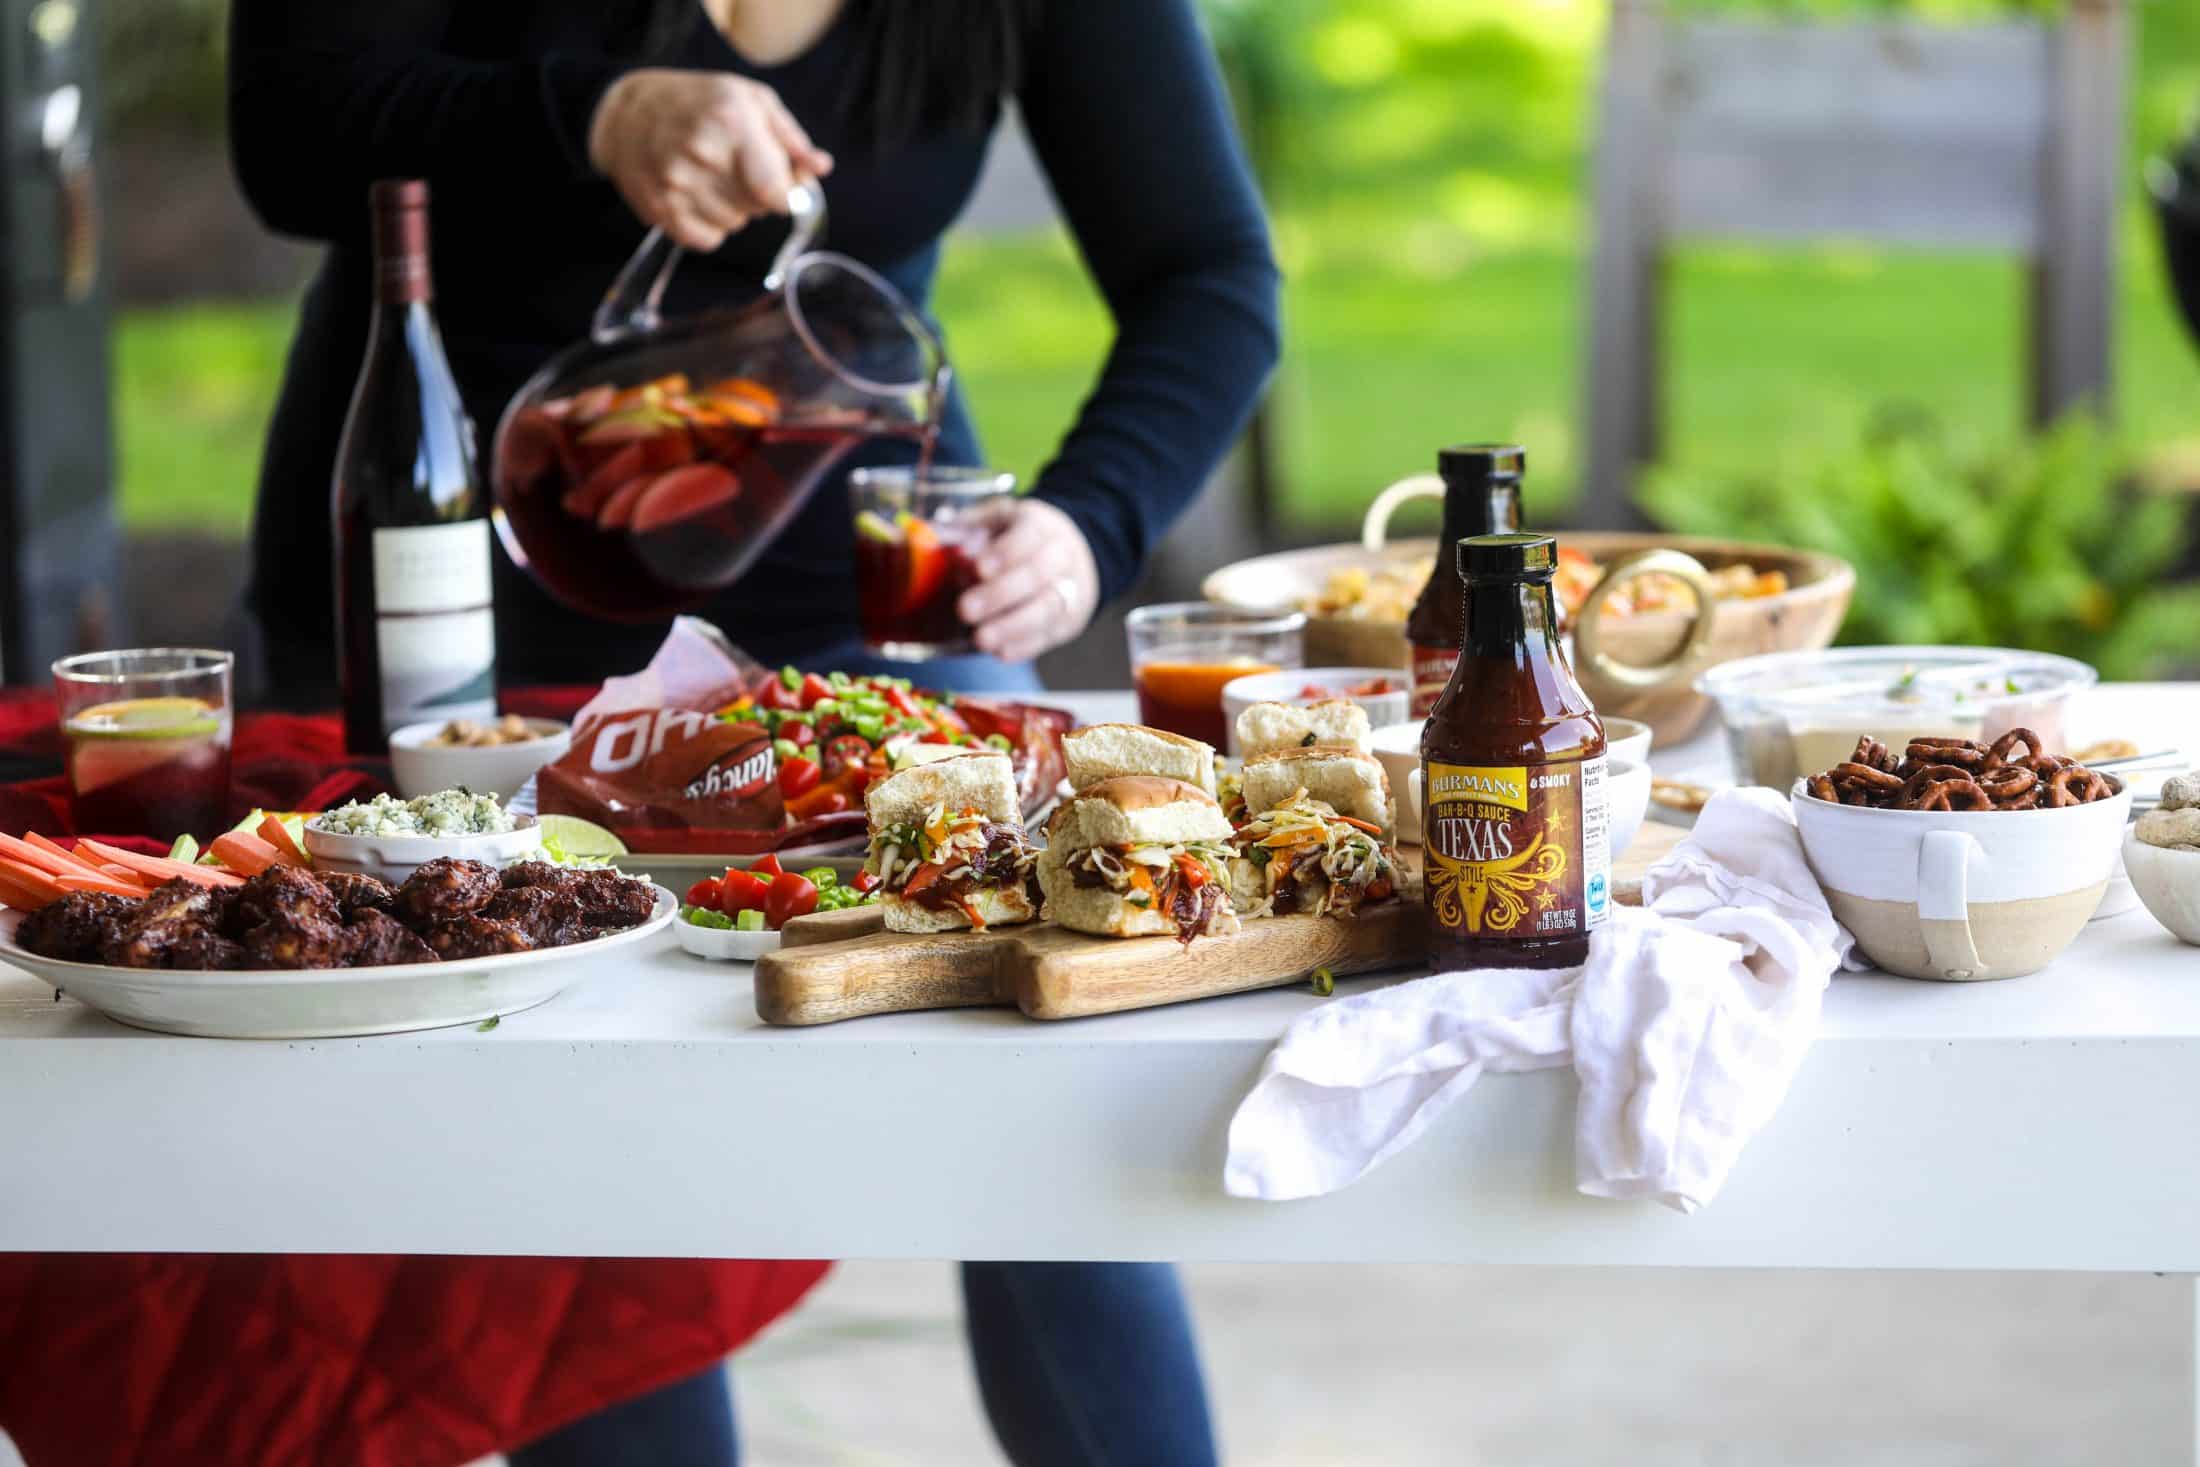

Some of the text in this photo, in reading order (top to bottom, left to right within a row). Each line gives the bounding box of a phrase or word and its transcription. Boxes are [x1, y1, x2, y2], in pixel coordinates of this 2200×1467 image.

[1539, 774, 1571, 788] SMOKY
[1478, 804, 1511, 823] SAUCE
[1438, 819, 1513, 861] TEXAS
[1459, 866, 1485, 883] STYLE
